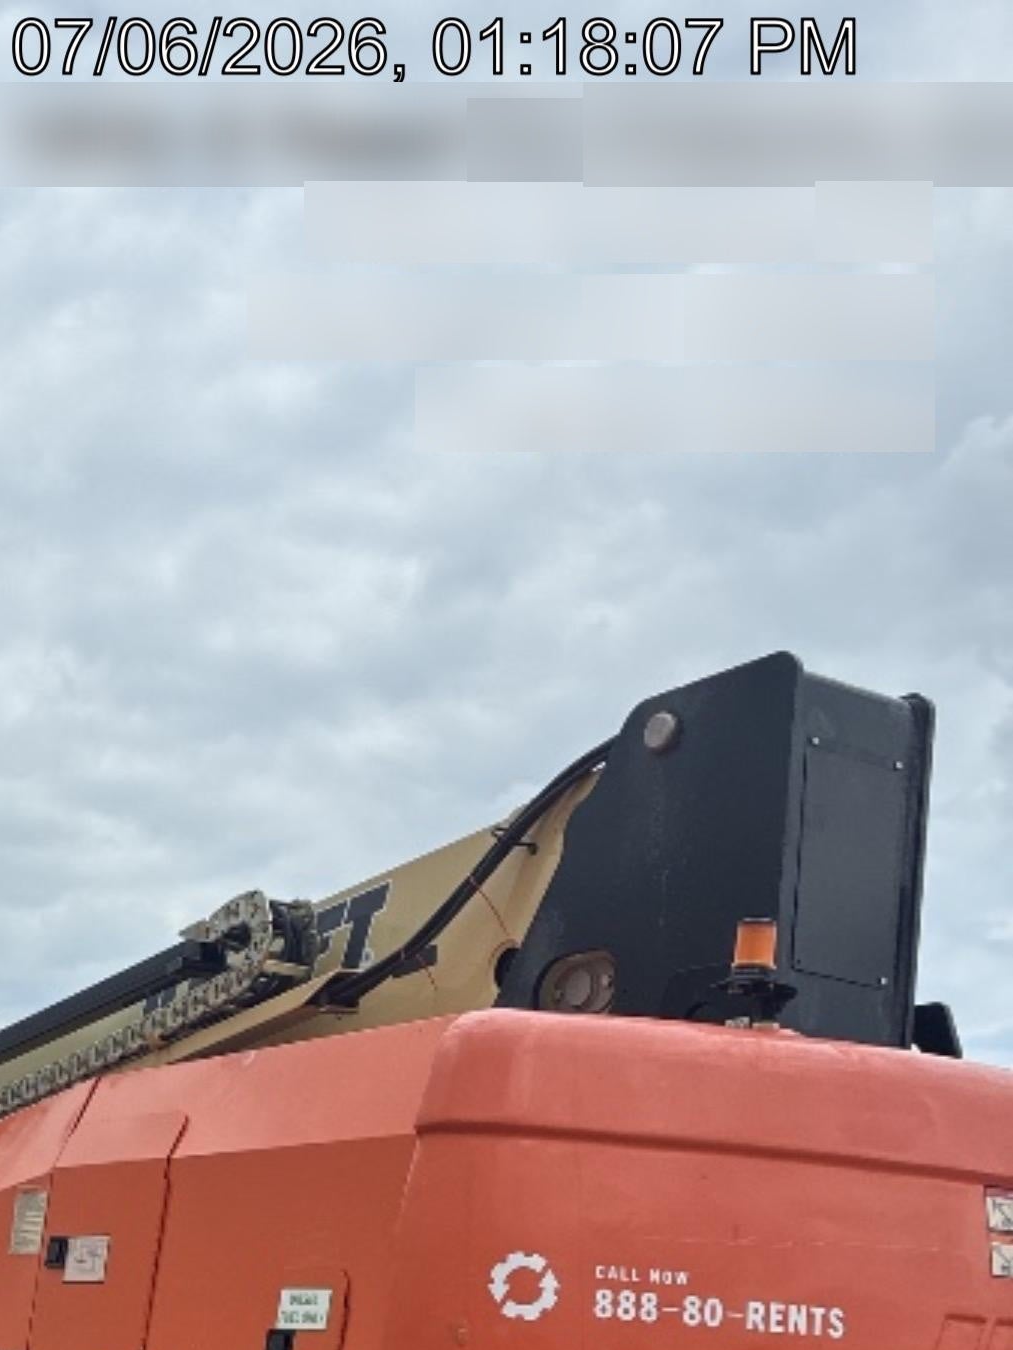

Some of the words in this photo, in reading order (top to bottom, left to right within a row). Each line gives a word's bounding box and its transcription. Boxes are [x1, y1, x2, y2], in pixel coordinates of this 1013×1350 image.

[595, 1265, 640, 1283] CALL
[649, 1268, 689, 1286] NOW
[594, 1289, 846, 1339] 888-80-RENTS
